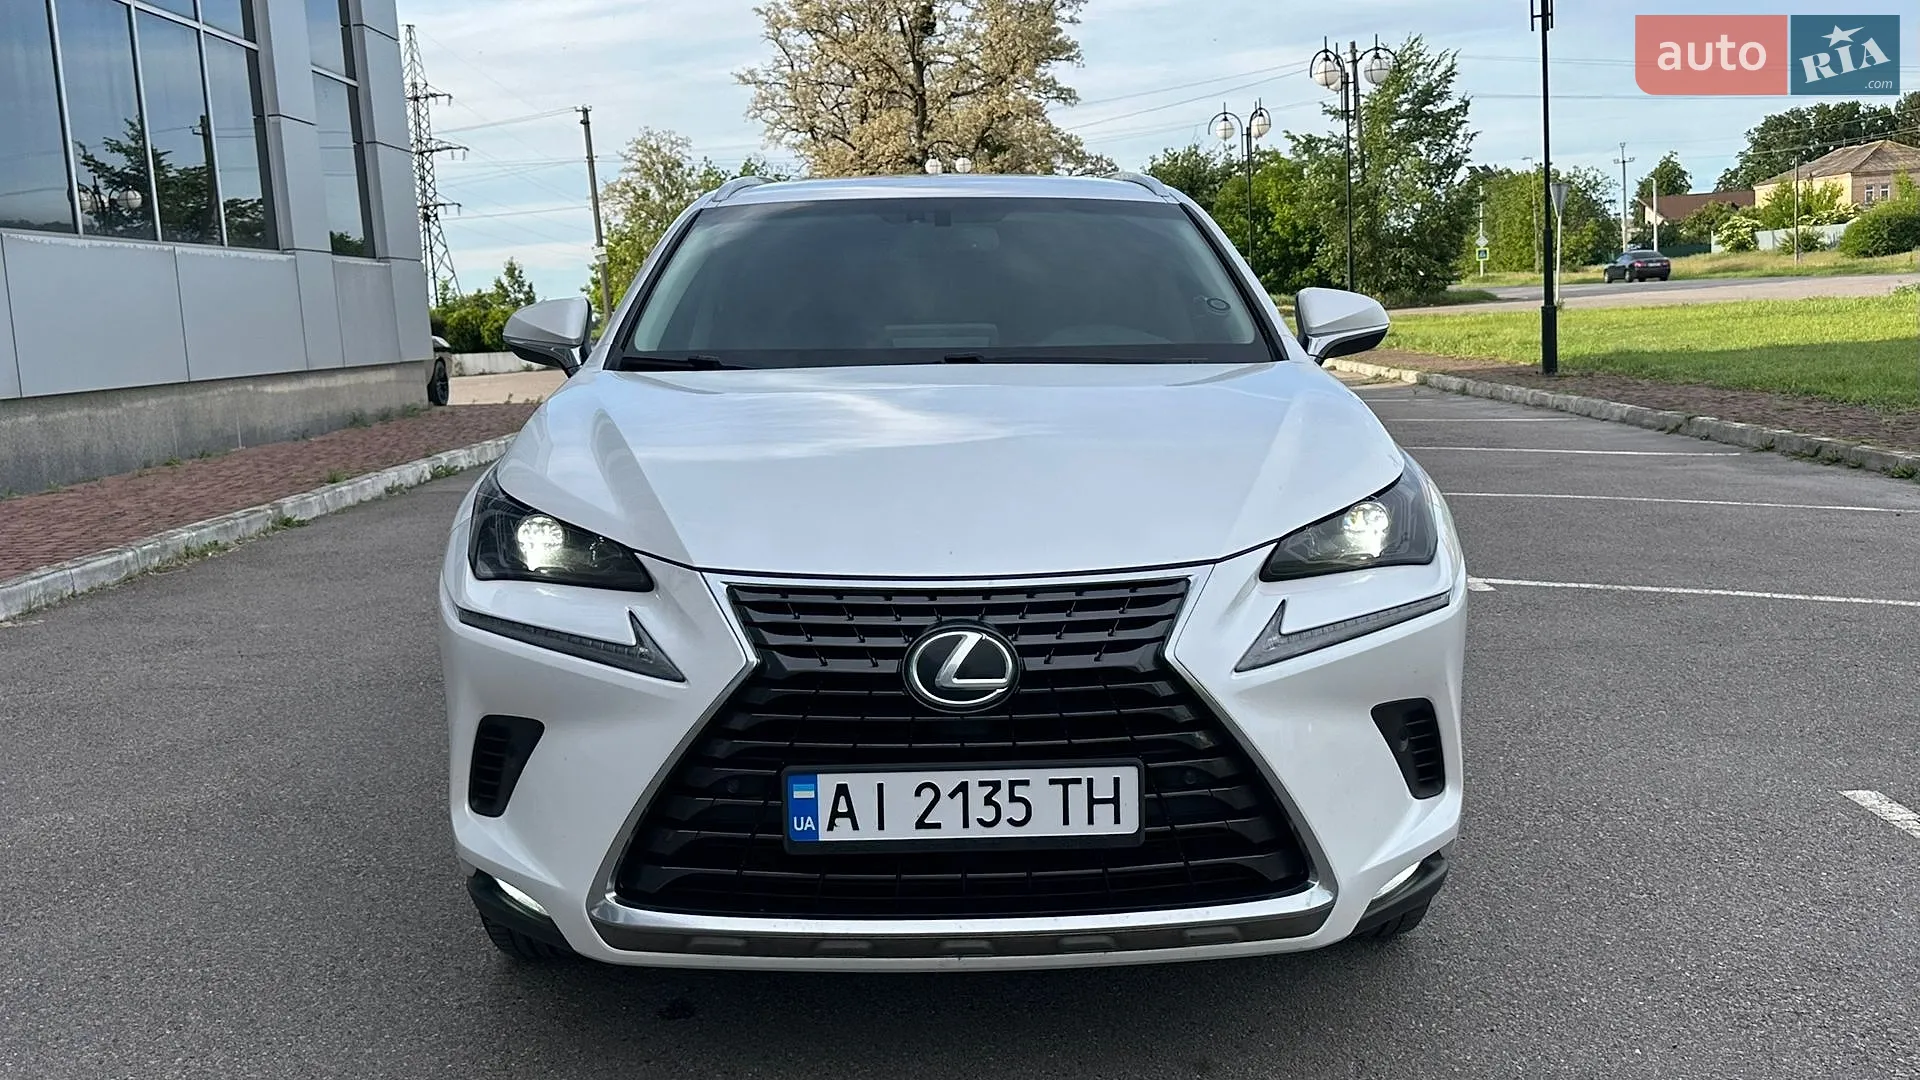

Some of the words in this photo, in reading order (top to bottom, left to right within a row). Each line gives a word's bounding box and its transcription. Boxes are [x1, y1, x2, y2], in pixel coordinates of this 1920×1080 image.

[826, 782, 885, 831] AI
[913, 779, 1033, 830] 2135
[1048, 776, 1121, 826] TH
[793, 815, 816, 831] UA
